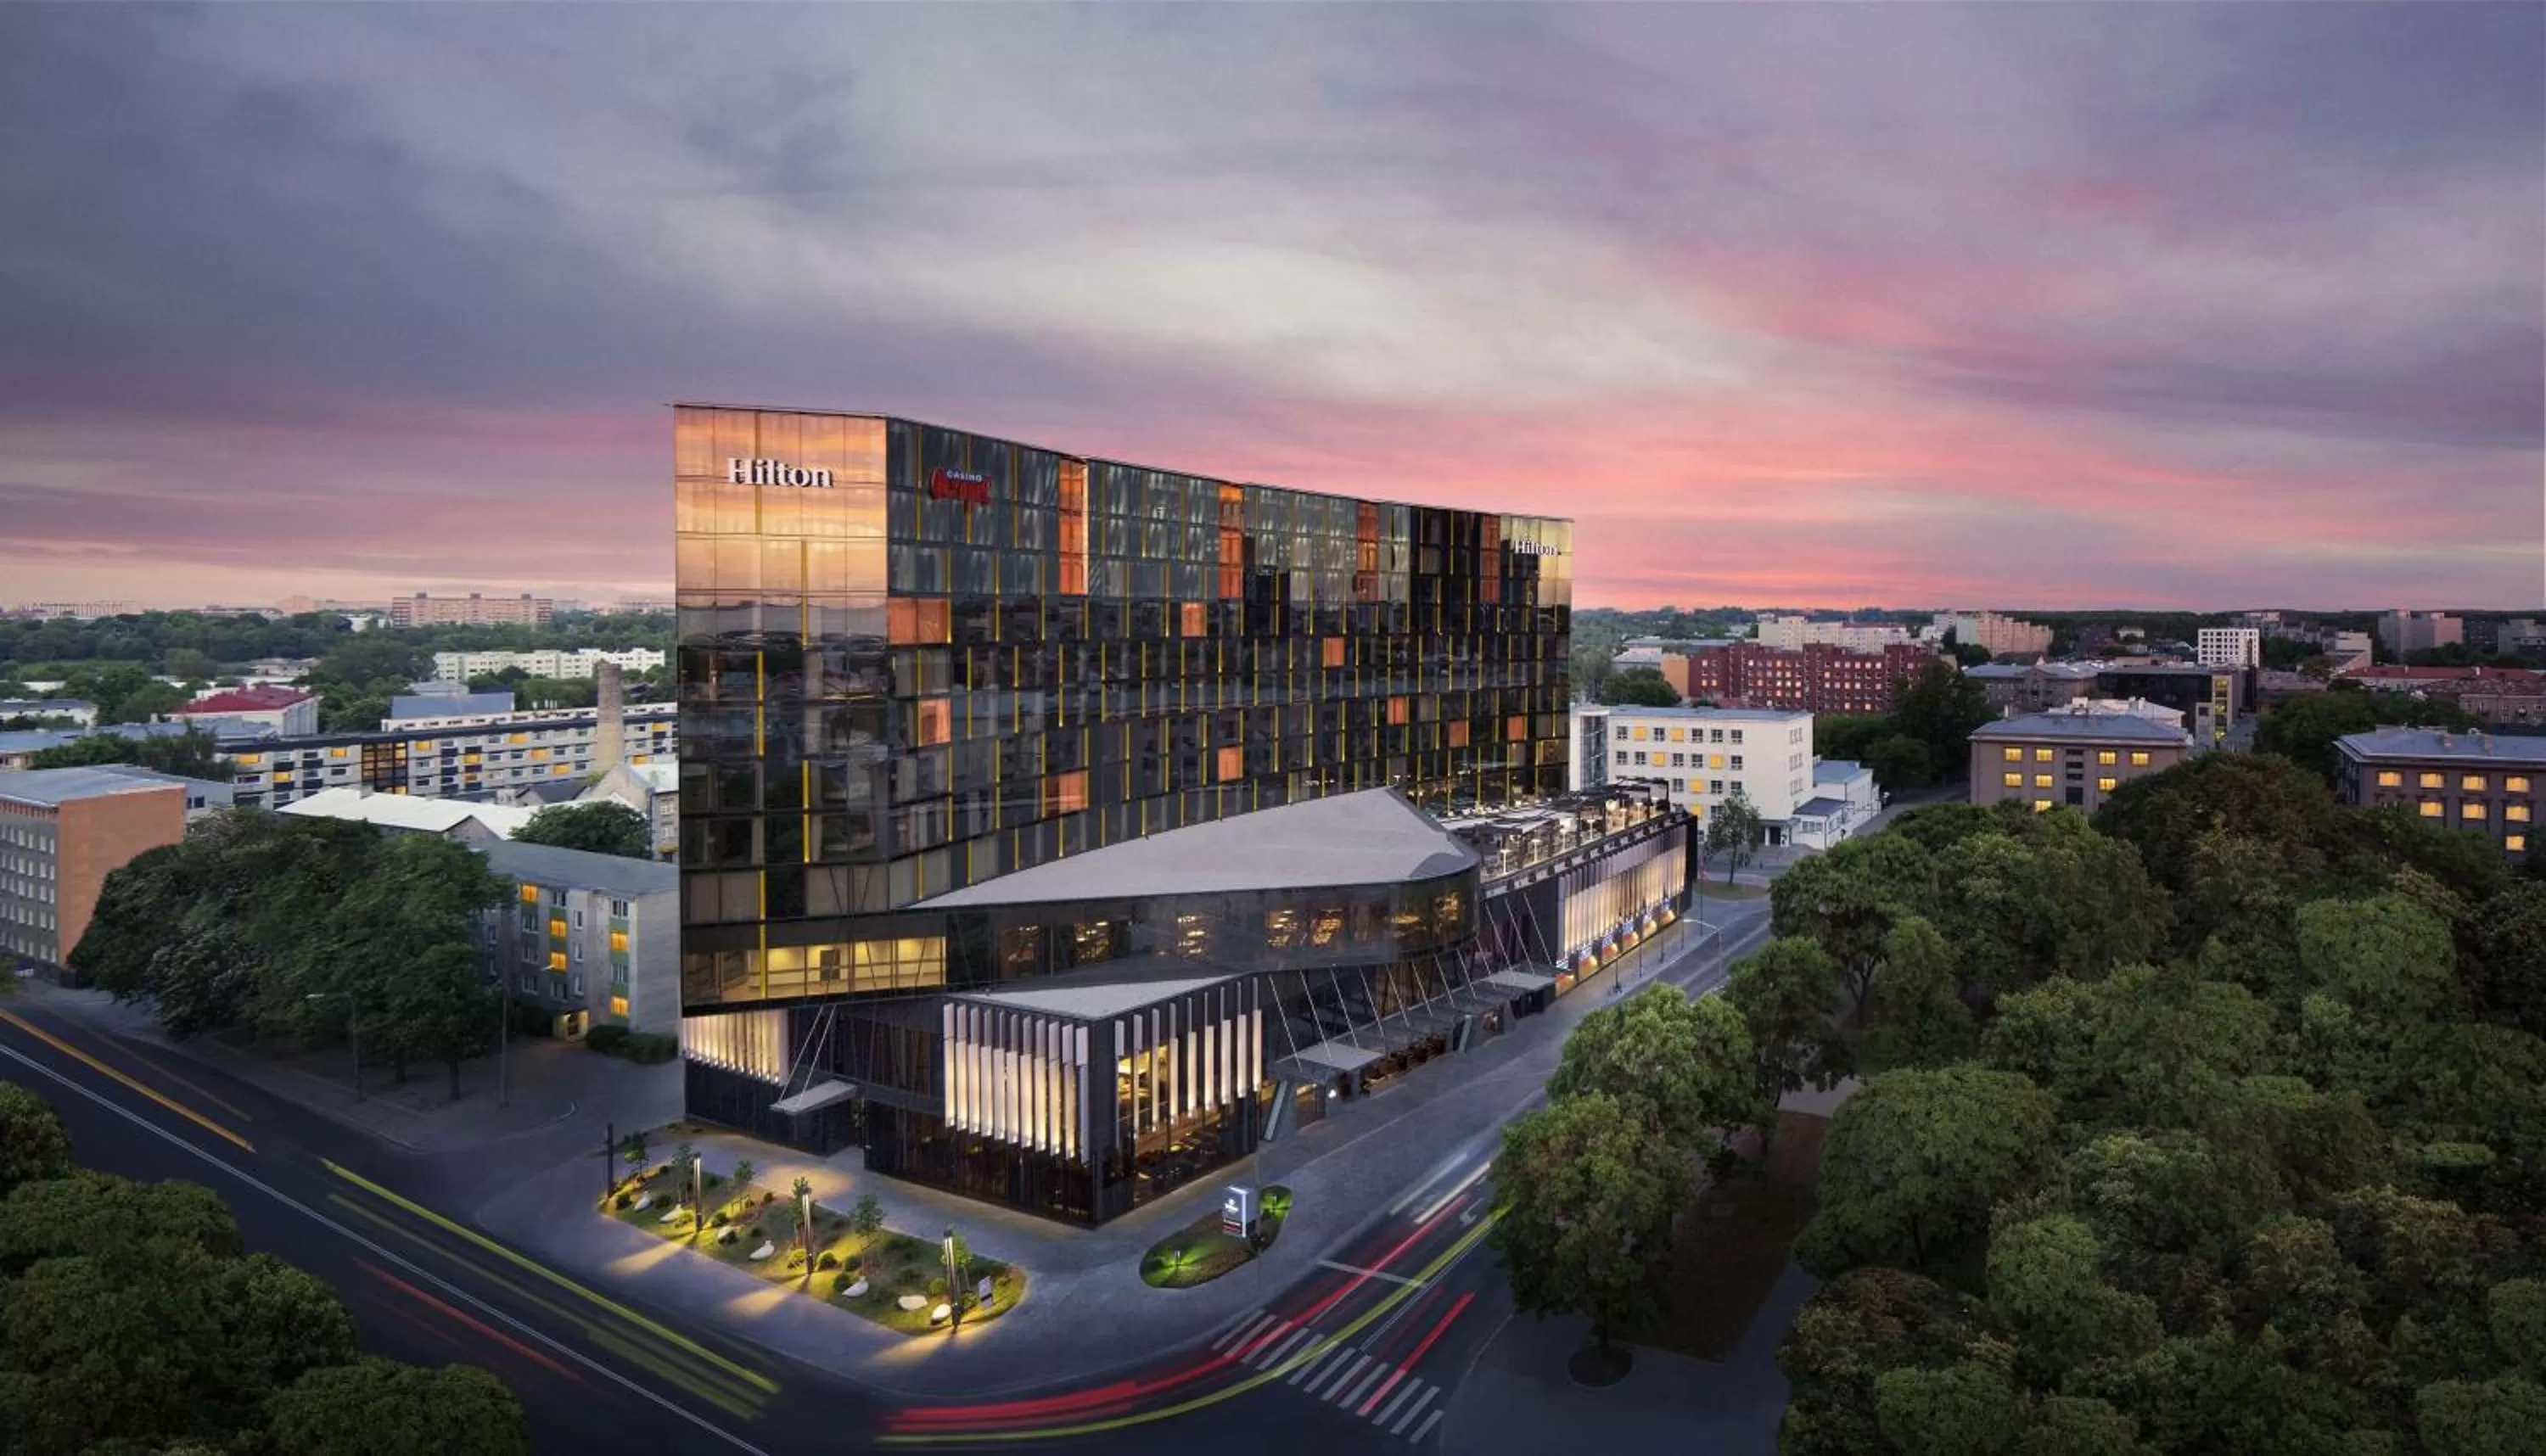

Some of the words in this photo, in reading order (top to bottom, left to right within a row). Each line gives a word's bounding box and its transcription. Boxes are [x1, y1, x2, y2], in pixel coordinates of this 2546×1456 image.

[727, 457, 833, 488] Hilton
[946, 469, 982, 483] CASINO
[1514, 539, 1558, 557] Hilton
